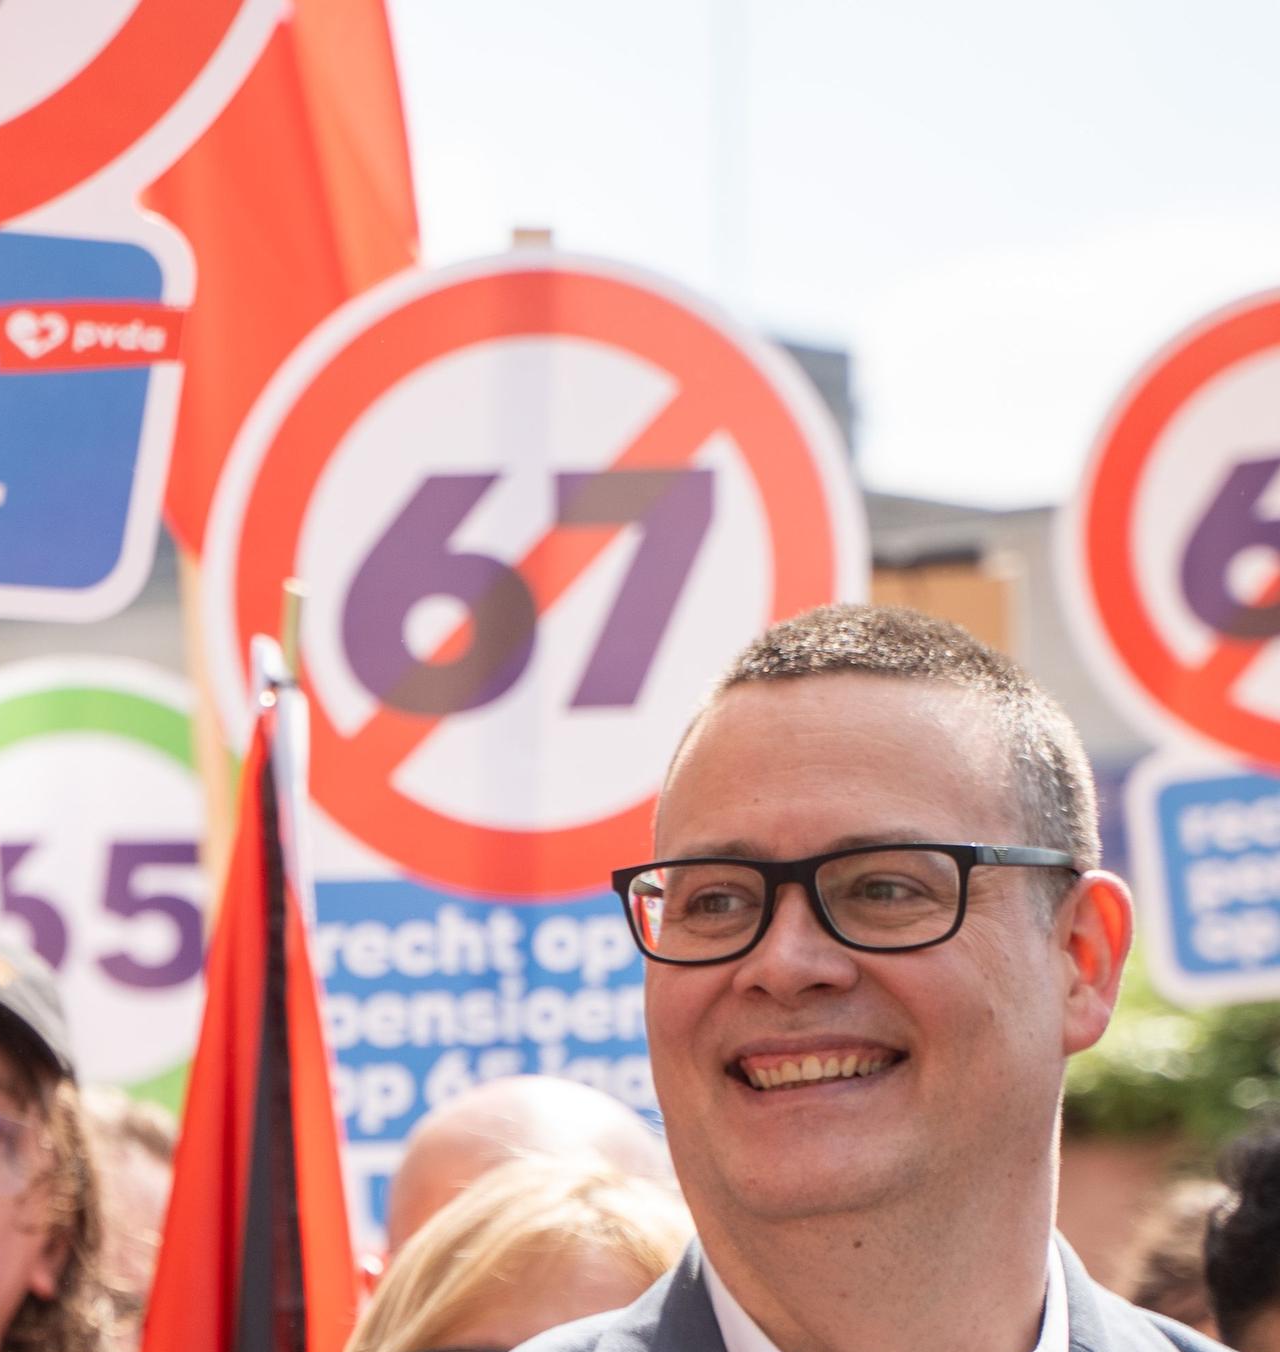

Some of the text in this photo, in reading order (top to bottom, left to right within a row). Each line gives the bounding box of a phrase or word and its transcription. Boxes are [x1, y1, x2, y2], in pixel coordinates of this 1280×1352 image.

[70, 318, 167, 355] pvda
[343, 467, 717, 719] 67
[316, 904, 633, 986] recht op
